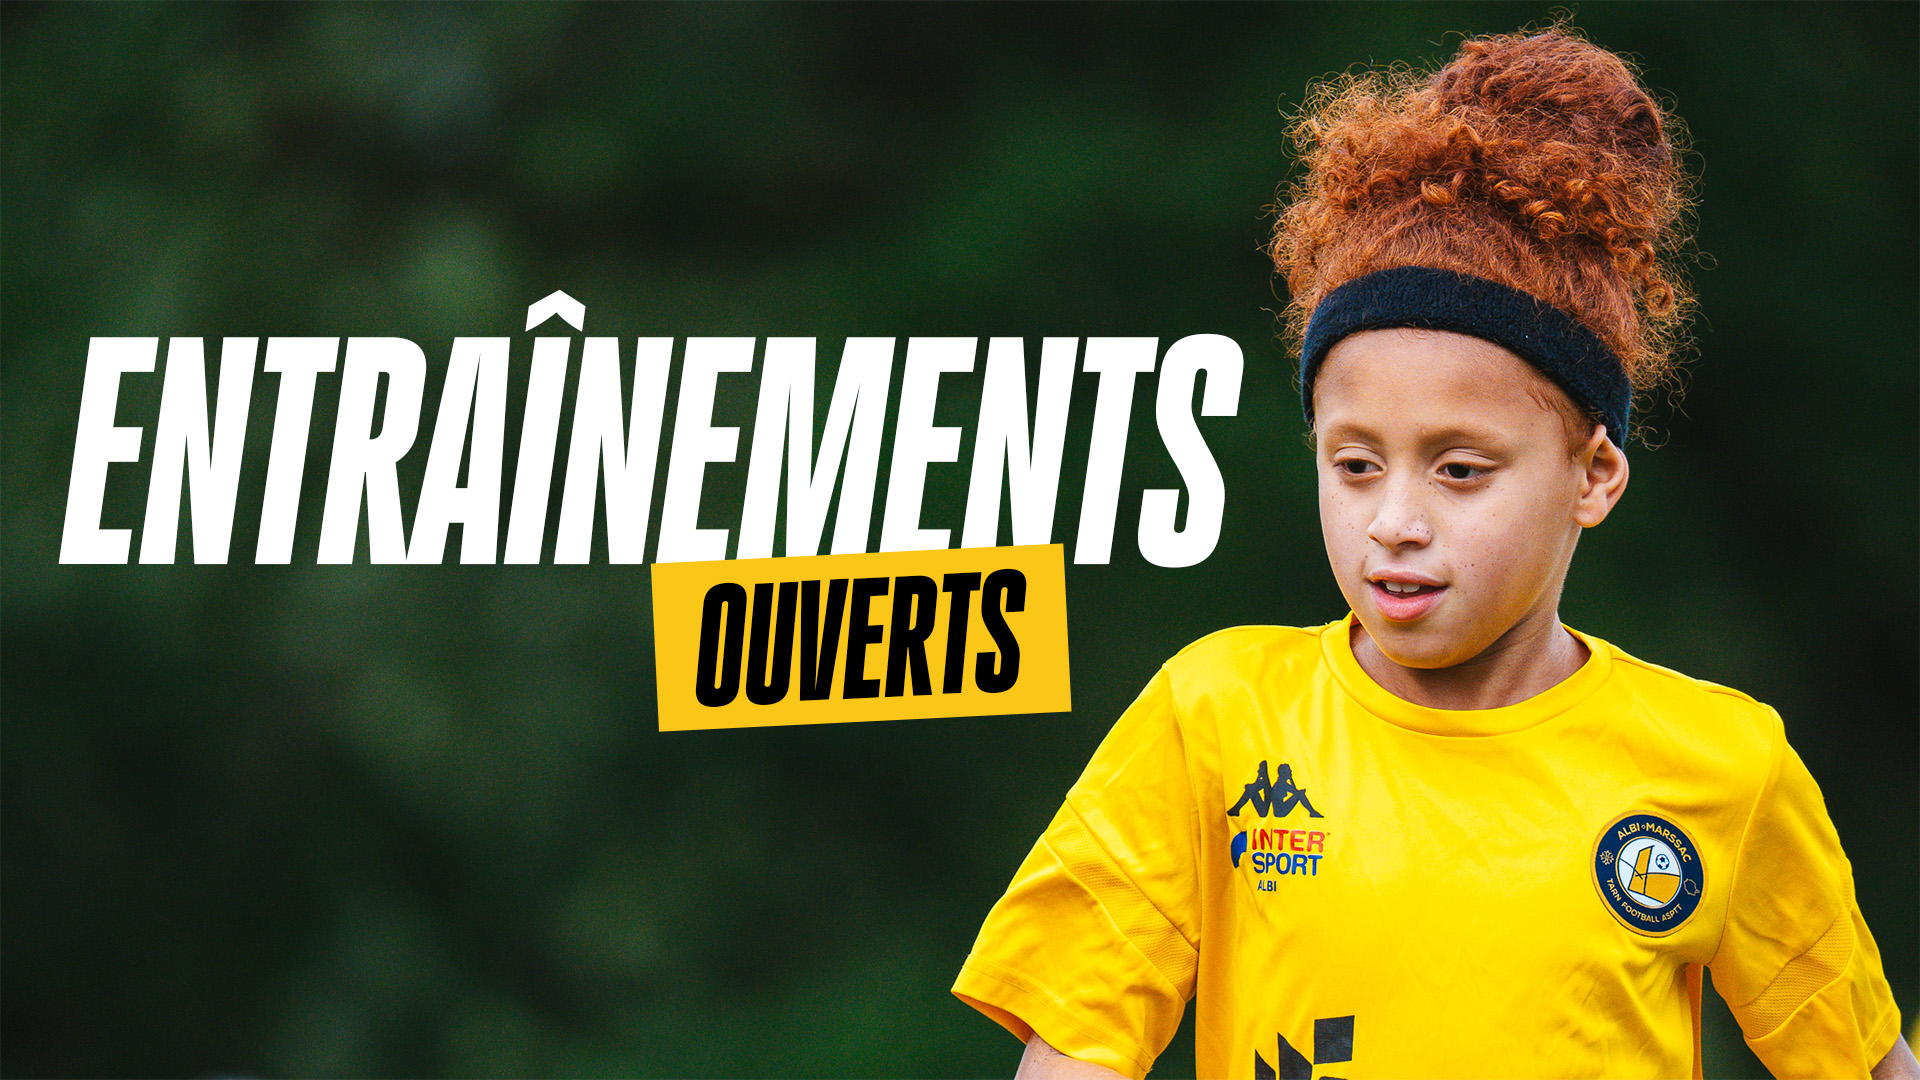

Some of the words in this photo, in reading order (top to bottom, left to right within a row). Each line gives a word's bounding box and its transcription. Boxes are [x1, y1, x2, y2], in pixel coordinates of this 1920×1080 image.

[1252, 828, 1326, 853] INTER
[1617, 822, 1641, 840] ALBI
[1645, 822, 1692, 863] MARSSAC
[1251, 851, 1324, 877] SPORT
[1257, 879, 1277, 892] ALBI
[1606, 878, 1622, 902] TARN
[1621, 901, 1660, 923] FOOTBALL
[1661, 903, 1683, 922] ASPTT
